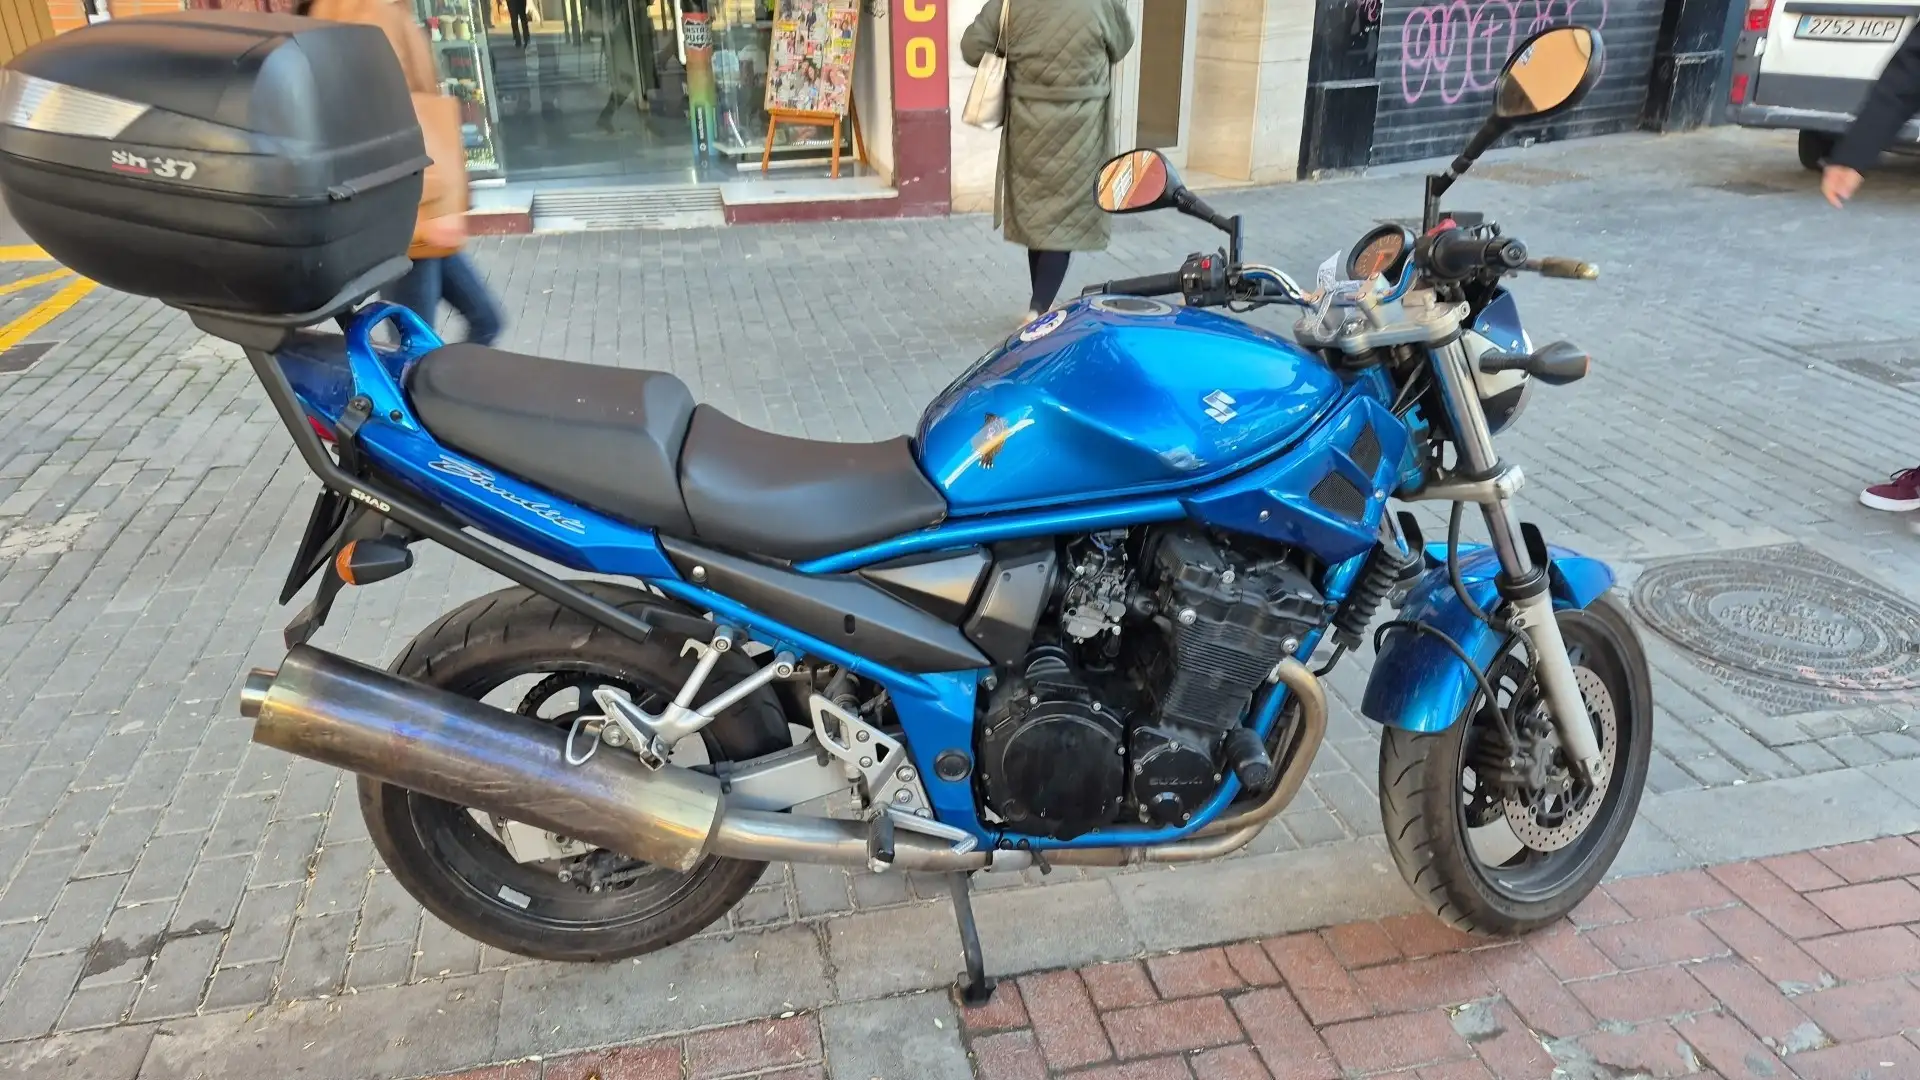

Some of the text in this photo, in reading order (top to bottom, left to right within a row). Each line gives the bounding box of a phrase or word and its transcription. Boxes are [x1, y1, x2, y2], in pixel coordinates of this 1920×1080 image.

[1808, 18, 1896, 37] 2752 HCP
[350, 488, 391, 512] SHAD
